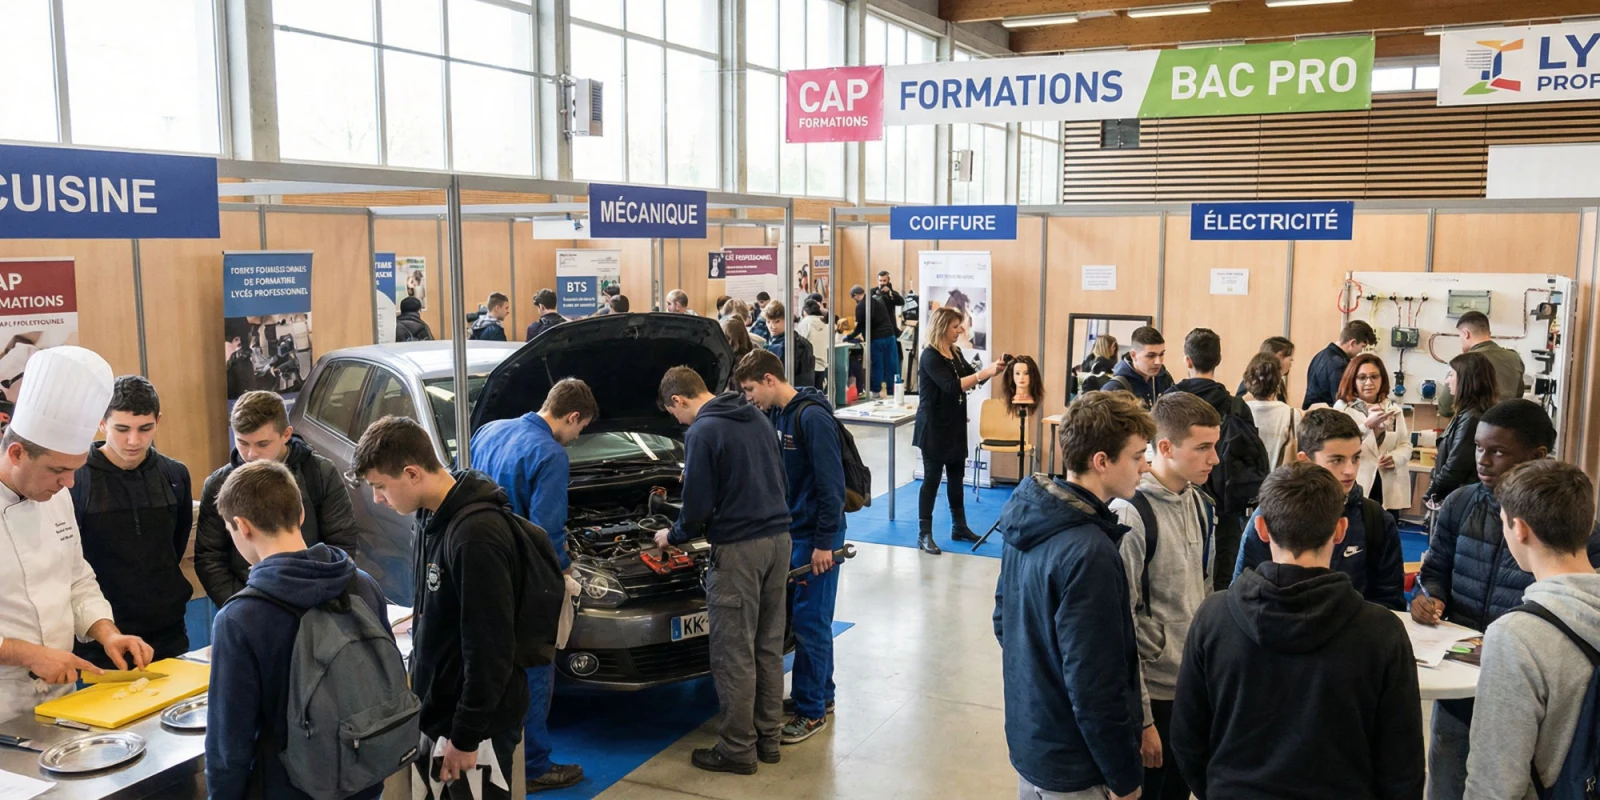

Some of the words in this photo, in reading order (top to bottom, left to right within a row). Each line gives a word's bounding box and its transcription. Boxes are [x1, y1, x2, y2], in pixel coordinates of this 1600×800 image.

[1539, 33, 1600, 70] LY
[799, 79, 869, 113] CAP
[900, 70, 1124, 111] FORMATIONS
[1171, 62, 1255, 101] BAC
[1268, 56, 1358, 96] PRO
[799, 116, 869, 129] FORMATIONS
[600, 196, 698, 225] MÉCANIQUE
[909, 215, 996, 231] COIFFURE
[1203, 208, 1339, 231] ÉLECTRICITÉ
[567, 281, 587, 292] BTS
